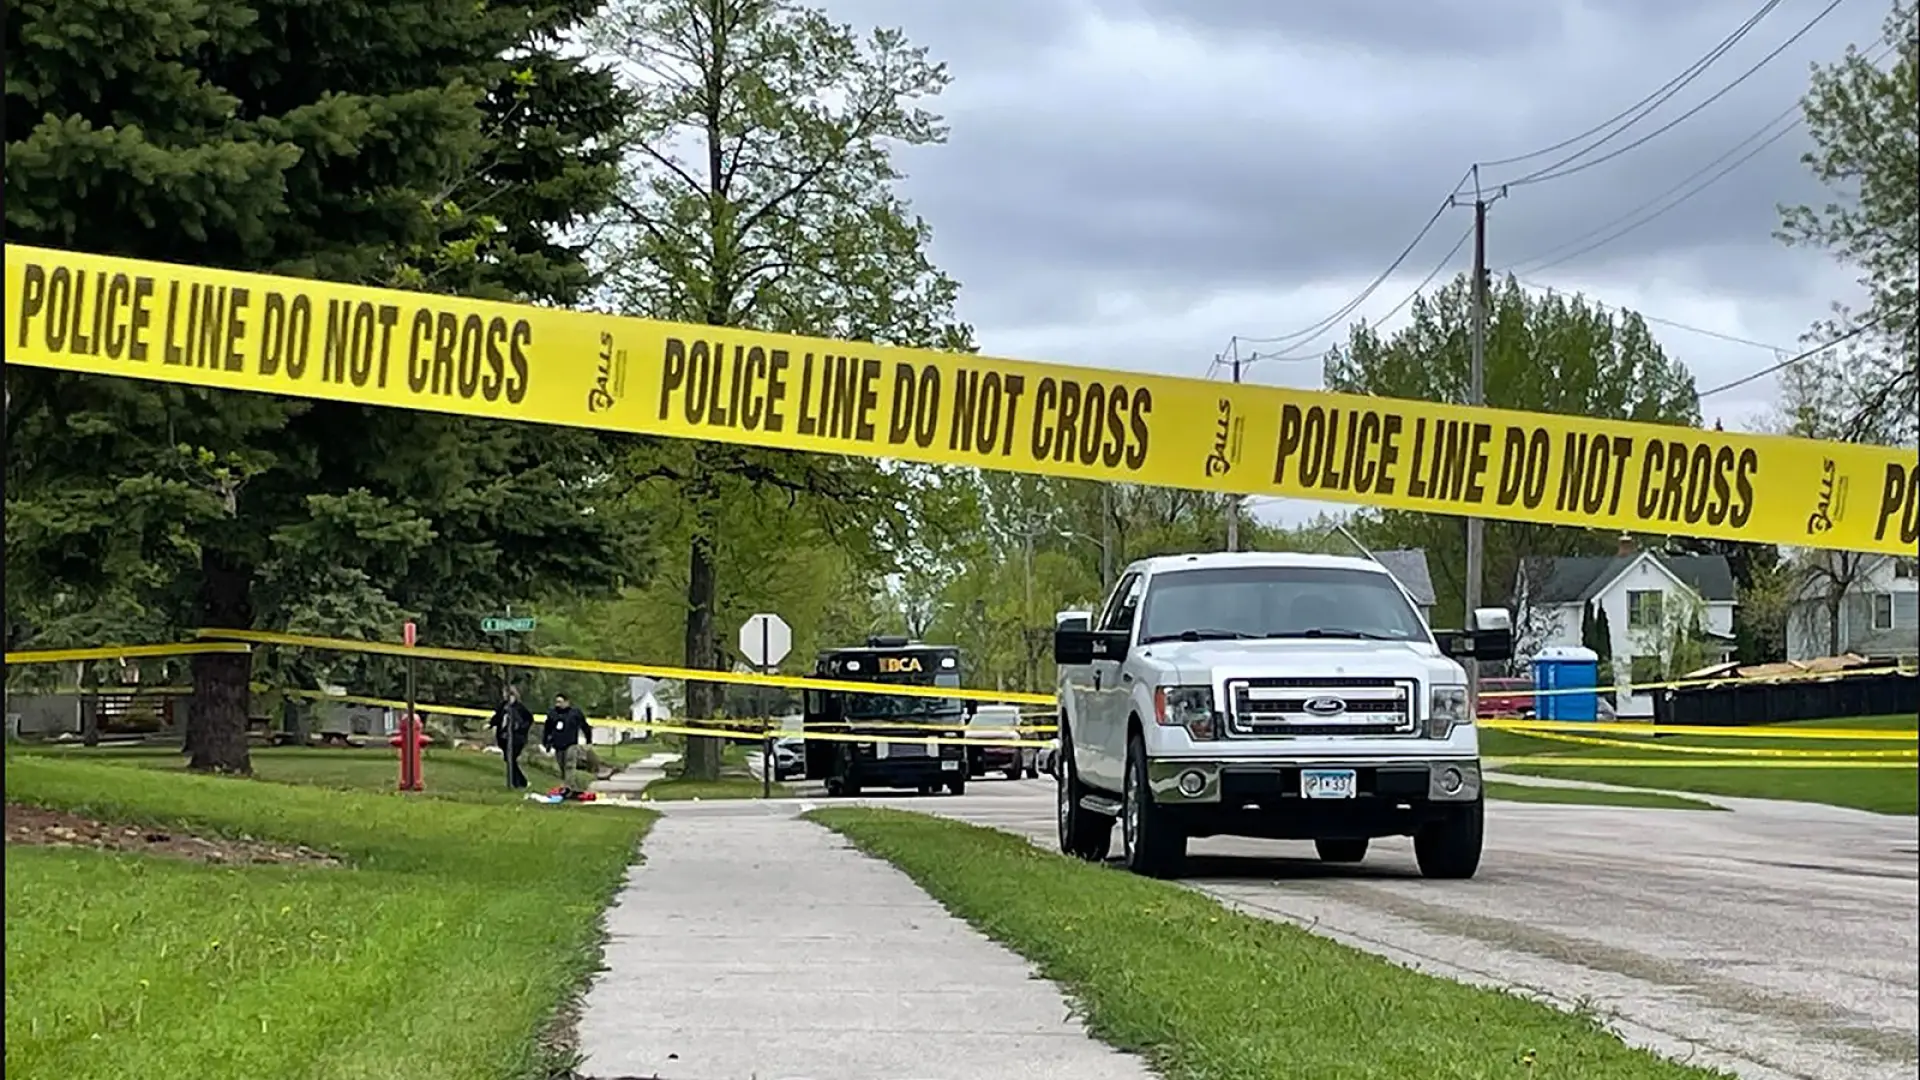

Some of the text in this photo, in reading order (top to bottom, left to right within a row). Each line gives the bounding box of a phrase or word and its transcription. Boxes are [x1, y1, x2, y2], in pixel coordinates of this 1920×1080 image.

[19, 263, 153, 361] POLICE
[164, 280, 250, 372] LINE
[259, 292, 311, 380] DO
[322, 299, 399, 388] NOT
[408, 308, 531, 404] CROSS
[659, 338, 790, 432] POLICE
[797, 352, 882, 442] LINE
[888, 362, 941, 448] DO
[949, 368, 1025, 457] NOT
[1031, 376, 1153, 471] CROSS
[1272, 403, 1404, 495] POLICE
[1407, 417, 1493, 504] LINE
[1496, 426, 1551, 510] DO
[1555, 431, 1634, 516] NOT
[1637, 438, 1758, 529] CROSS
[888, 657, 922, 673] BCA
